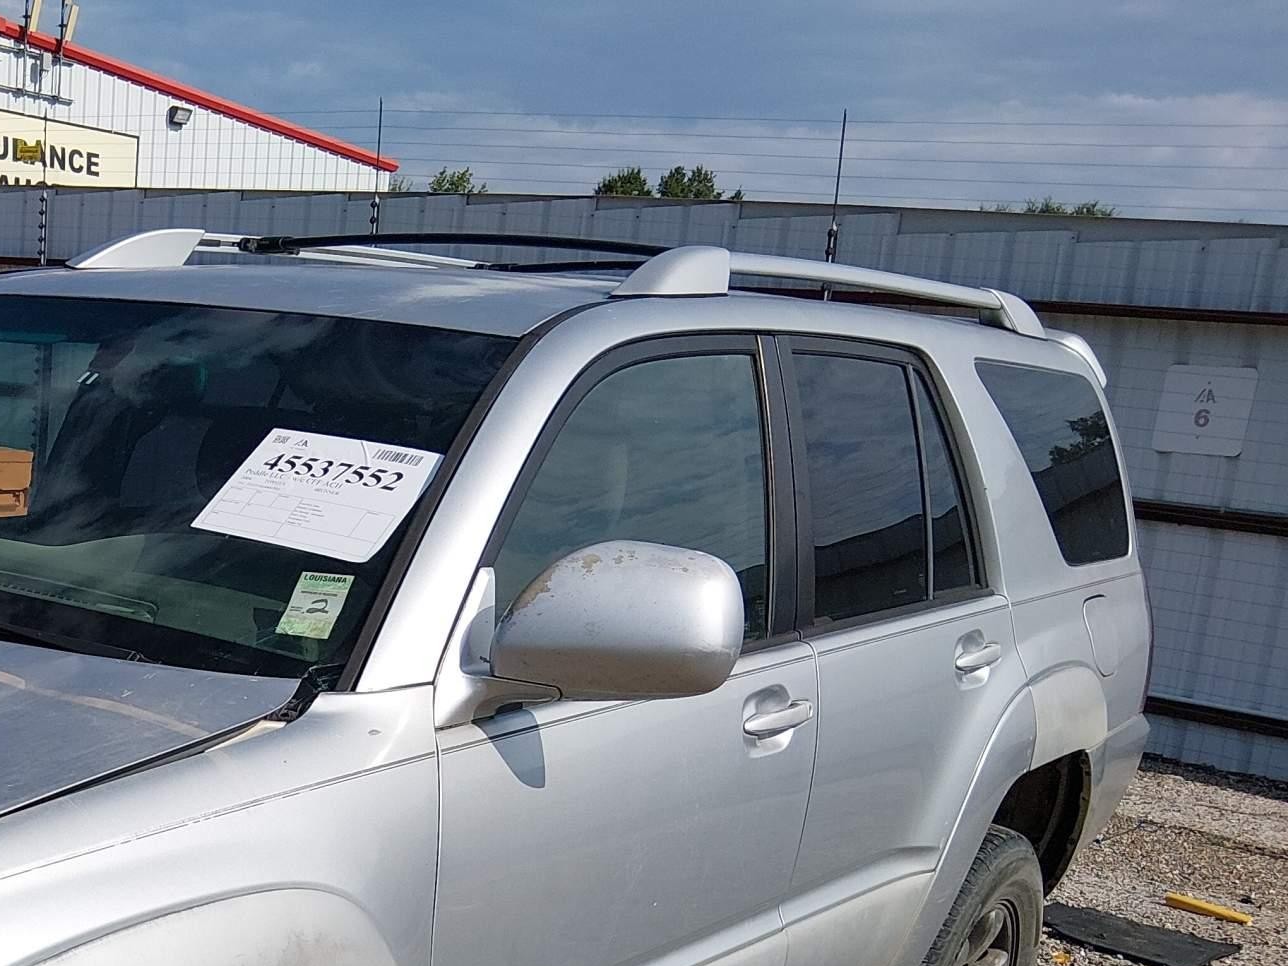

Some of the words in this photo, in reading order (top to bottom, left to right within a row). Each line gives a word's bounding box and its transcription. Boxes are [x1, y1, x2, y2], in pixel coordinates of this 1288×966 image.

[1194, 408, 1211, 428] 6
[263, 453, 404, 491] 45537552
[304, 573, 347, 584] LOUISIANA
